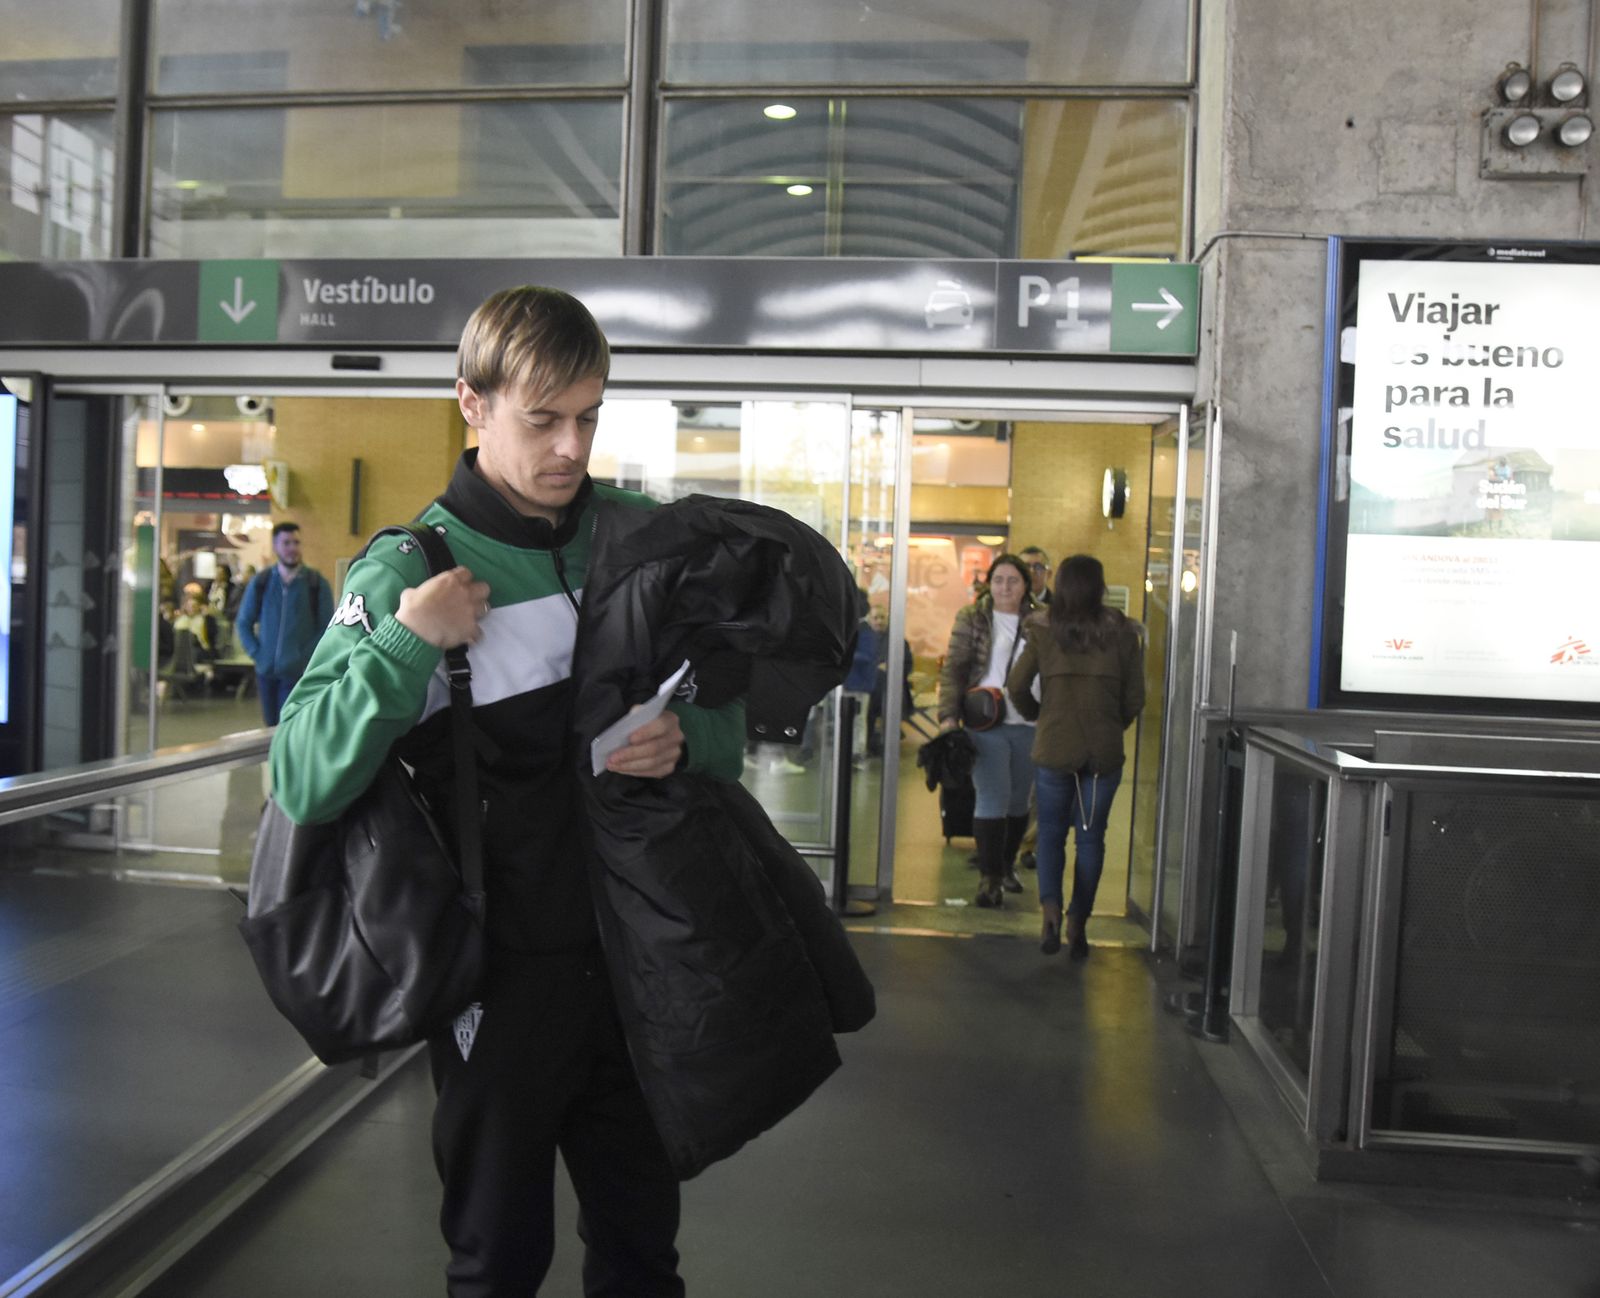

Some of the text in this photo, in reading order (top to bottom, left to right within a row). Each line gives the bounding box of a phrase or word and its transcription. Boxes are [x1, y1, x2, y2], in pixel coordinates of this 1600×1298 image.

[303, 276, 435, 304] Vestíbulo
[1018, 275, 1089, 328] P1
[300, 312, 336, 327] HALL
[1388, 292, 1500, 332] Viajar
[1442, 335, 1564, 368] bueno
[1385, 377, 1515, 413] para la
[1383, 418, 1486, 450] salud
